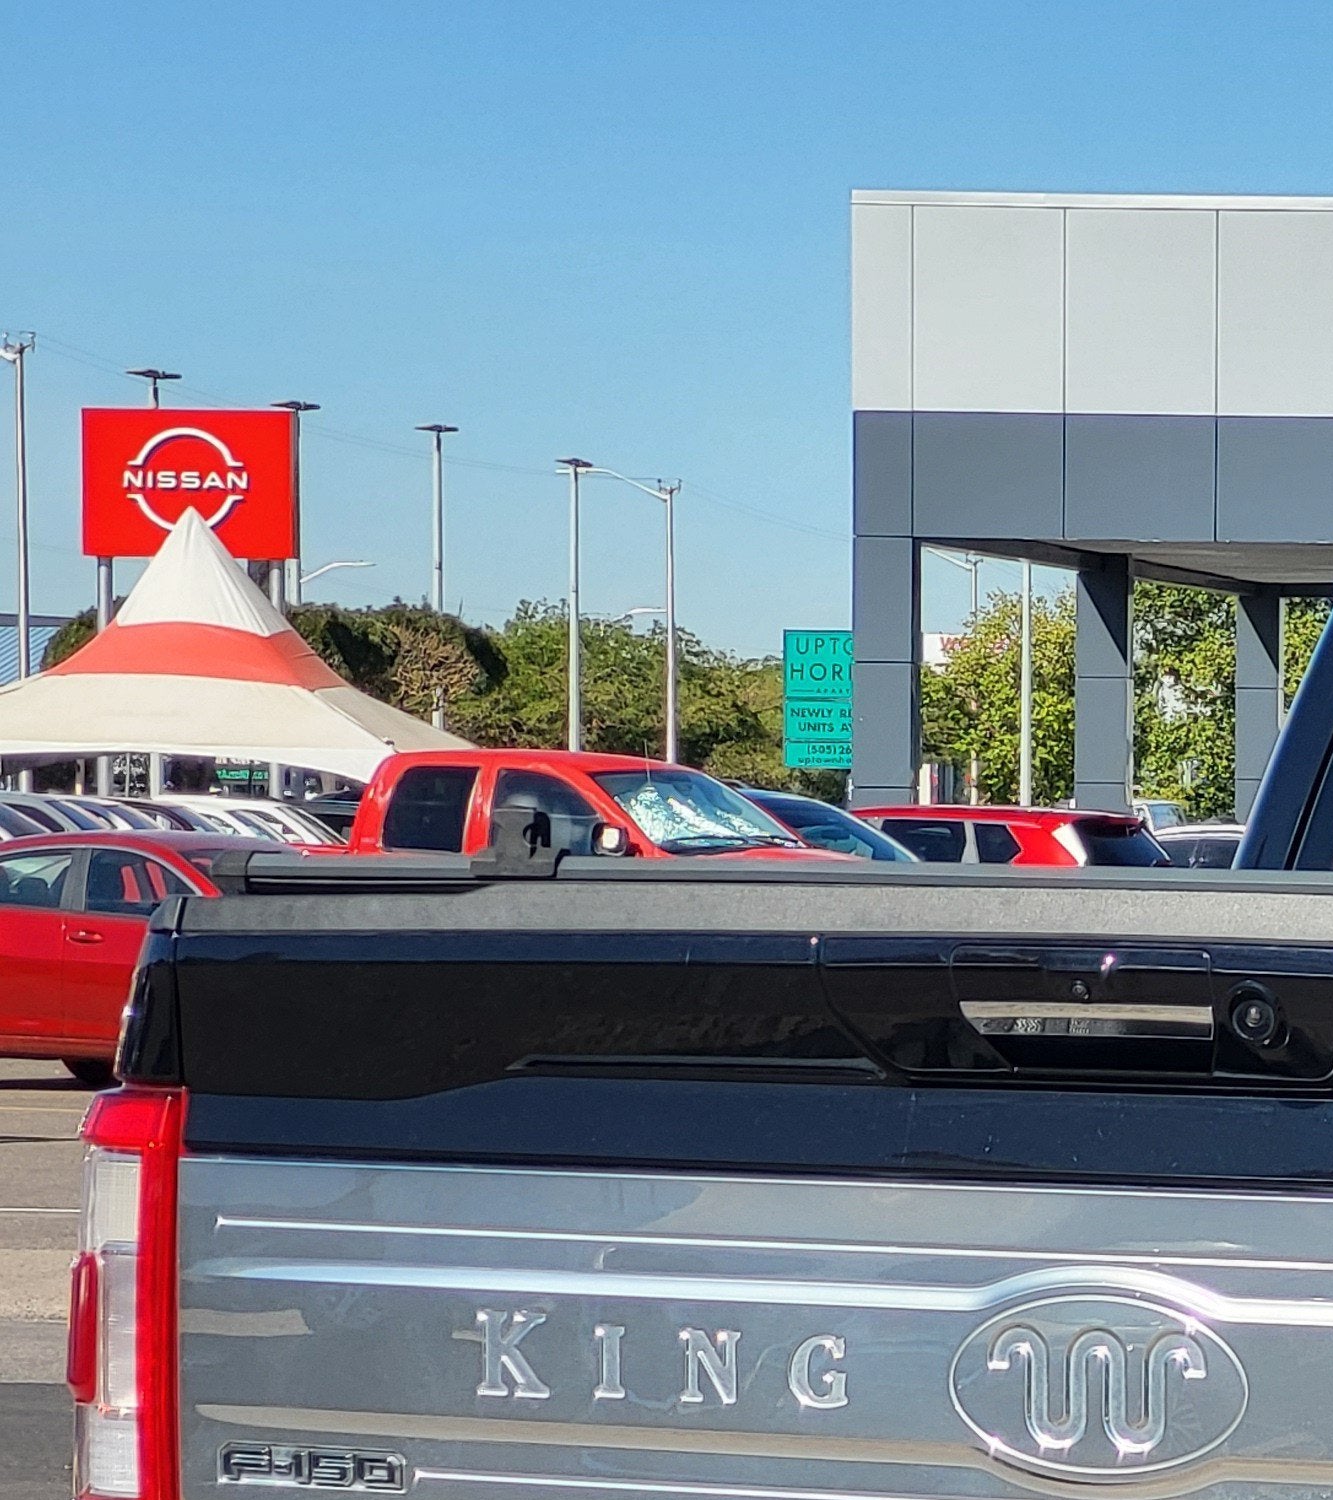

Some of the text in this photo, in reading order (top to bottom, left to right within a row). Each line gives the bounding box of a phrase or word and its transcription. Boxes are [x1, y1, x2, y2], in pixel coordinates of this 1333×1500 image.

[123, 470, 248, 489] NISSAN
[790, 707, 834, 718] NEWLY
[798, 721, 834, 733] UNITS
[476, 1309, 850, 1410] KING
[220, 1445, 406, 1491] F-150
